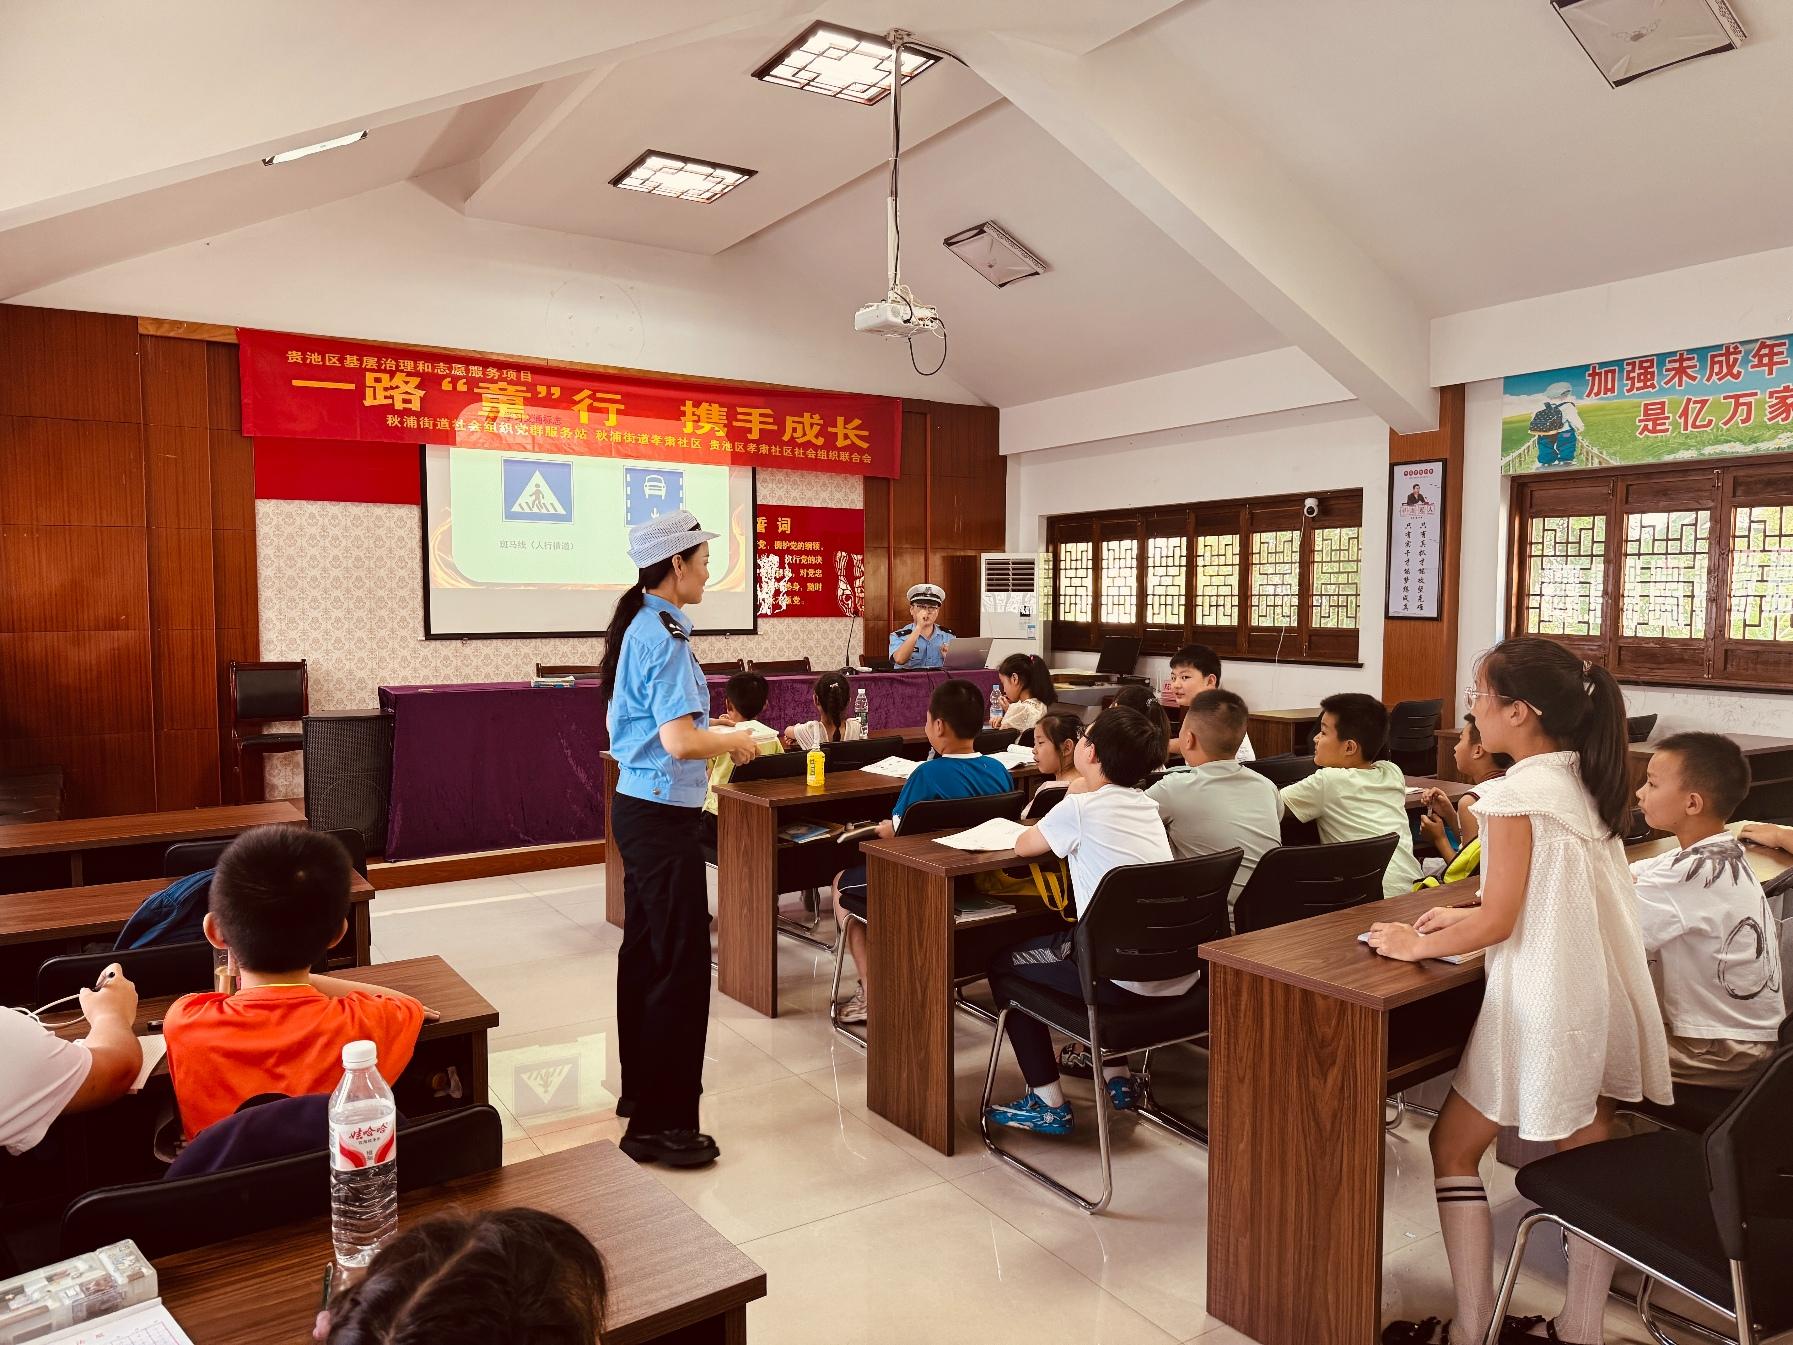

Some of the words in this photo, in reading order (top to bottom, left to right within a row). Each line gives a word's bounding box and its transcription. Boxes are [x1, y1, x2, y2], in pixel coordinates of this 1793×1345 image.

[286, 350, 533, 383] 贵池区基层治理和志愿服务项目
[1585, 340, 1790, 399] 加强未成年
[680, 400, 871, 449] 携手成长
[1636, 384, 1793, 437] 是亿万家
[386, 414, 587, 440] 秋浦街道社会组织党群服务站
[596, 430, 702, 449] 秋浦街道孝肃社区
[709, 440, 872, 464] 贵池区孝肃社区社会组织联合会
[349, 1123, 387, 1140] 娃哈哈
